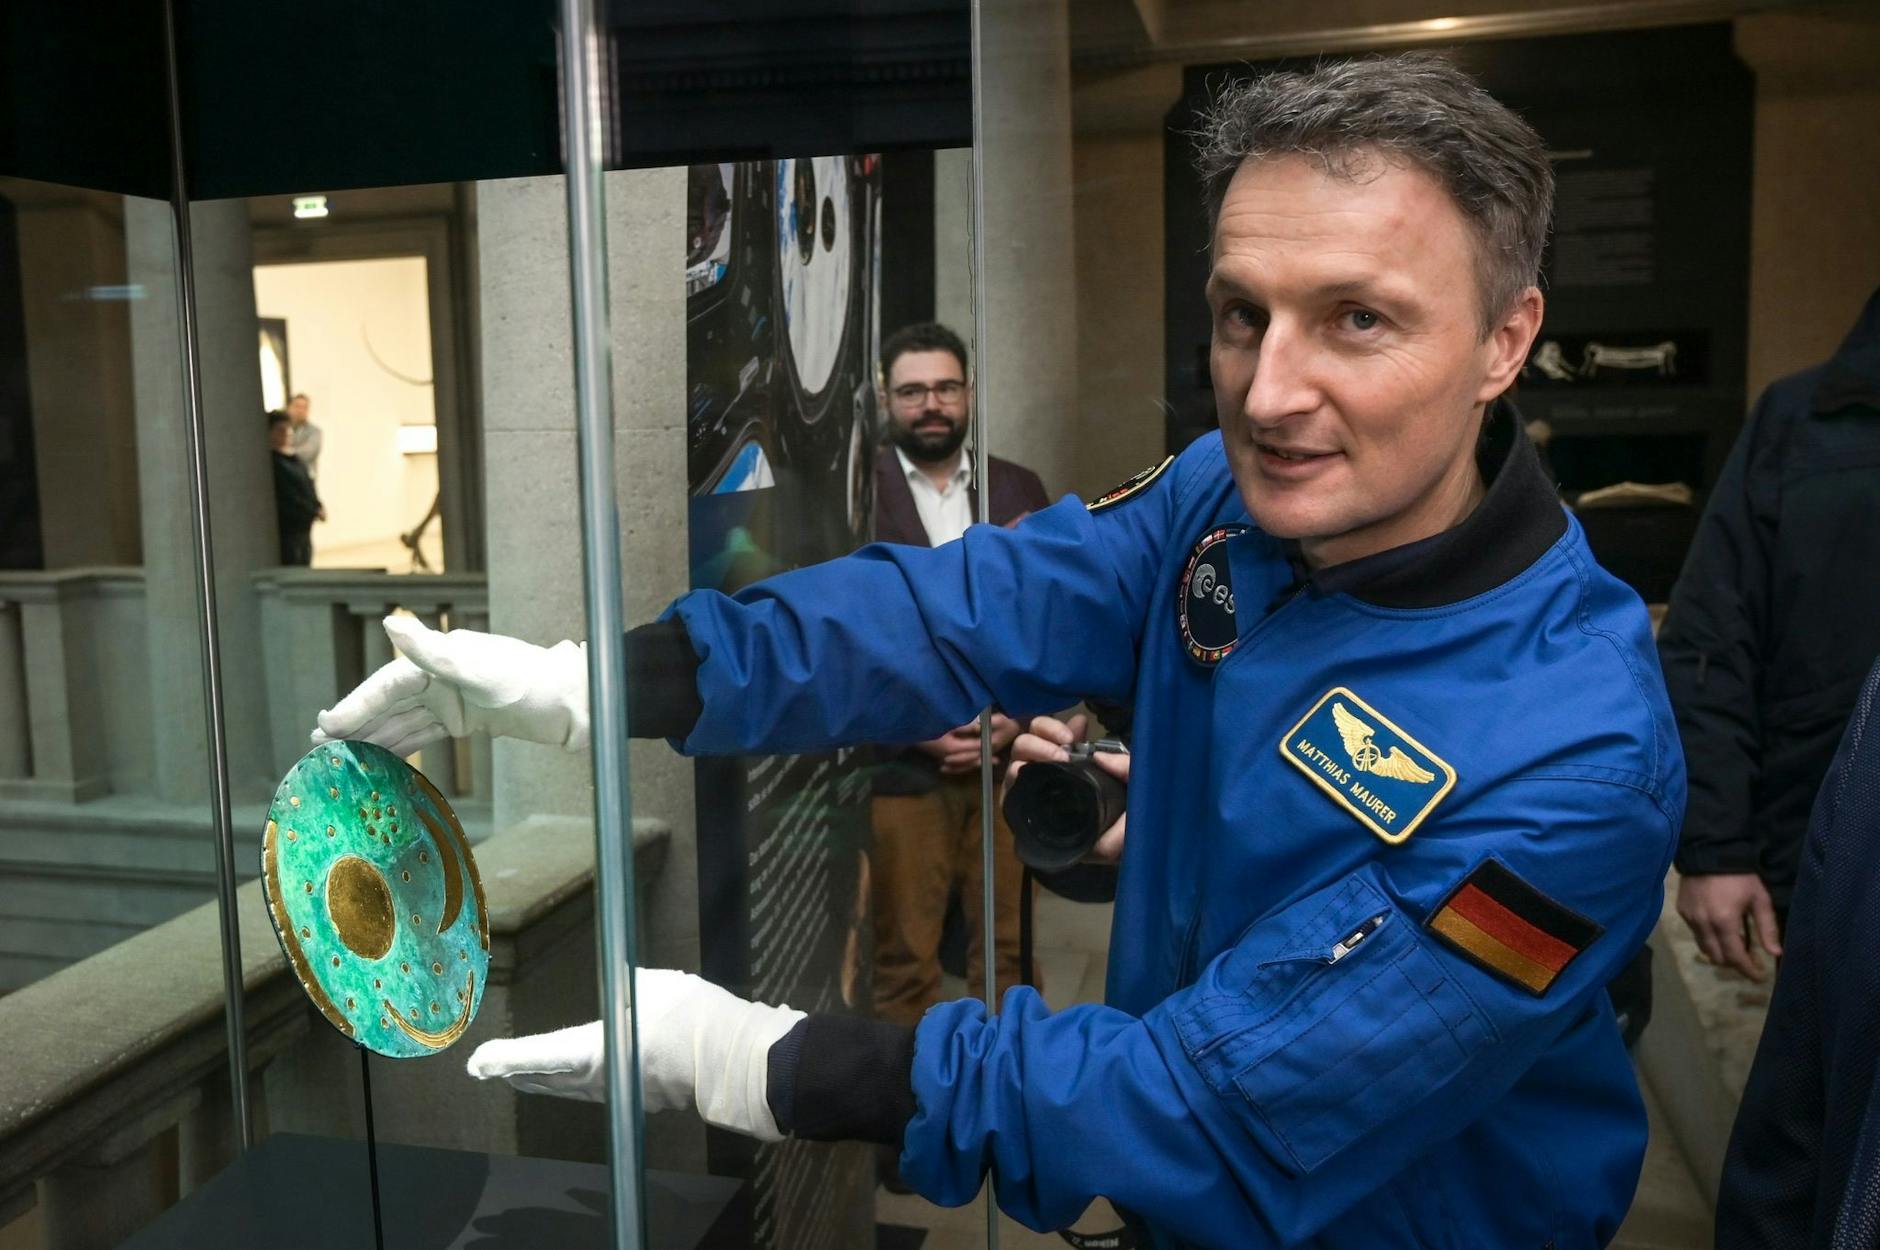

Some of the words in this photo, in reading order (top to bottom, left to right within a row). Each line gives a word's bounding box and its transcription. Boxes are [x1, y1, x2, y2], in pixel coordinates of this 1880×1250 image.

[1213, 584, 1235, 615] es
[1296, 739, 1351, 785] MATTHIAS
[1350, 782, 1397, 824] MAURER
